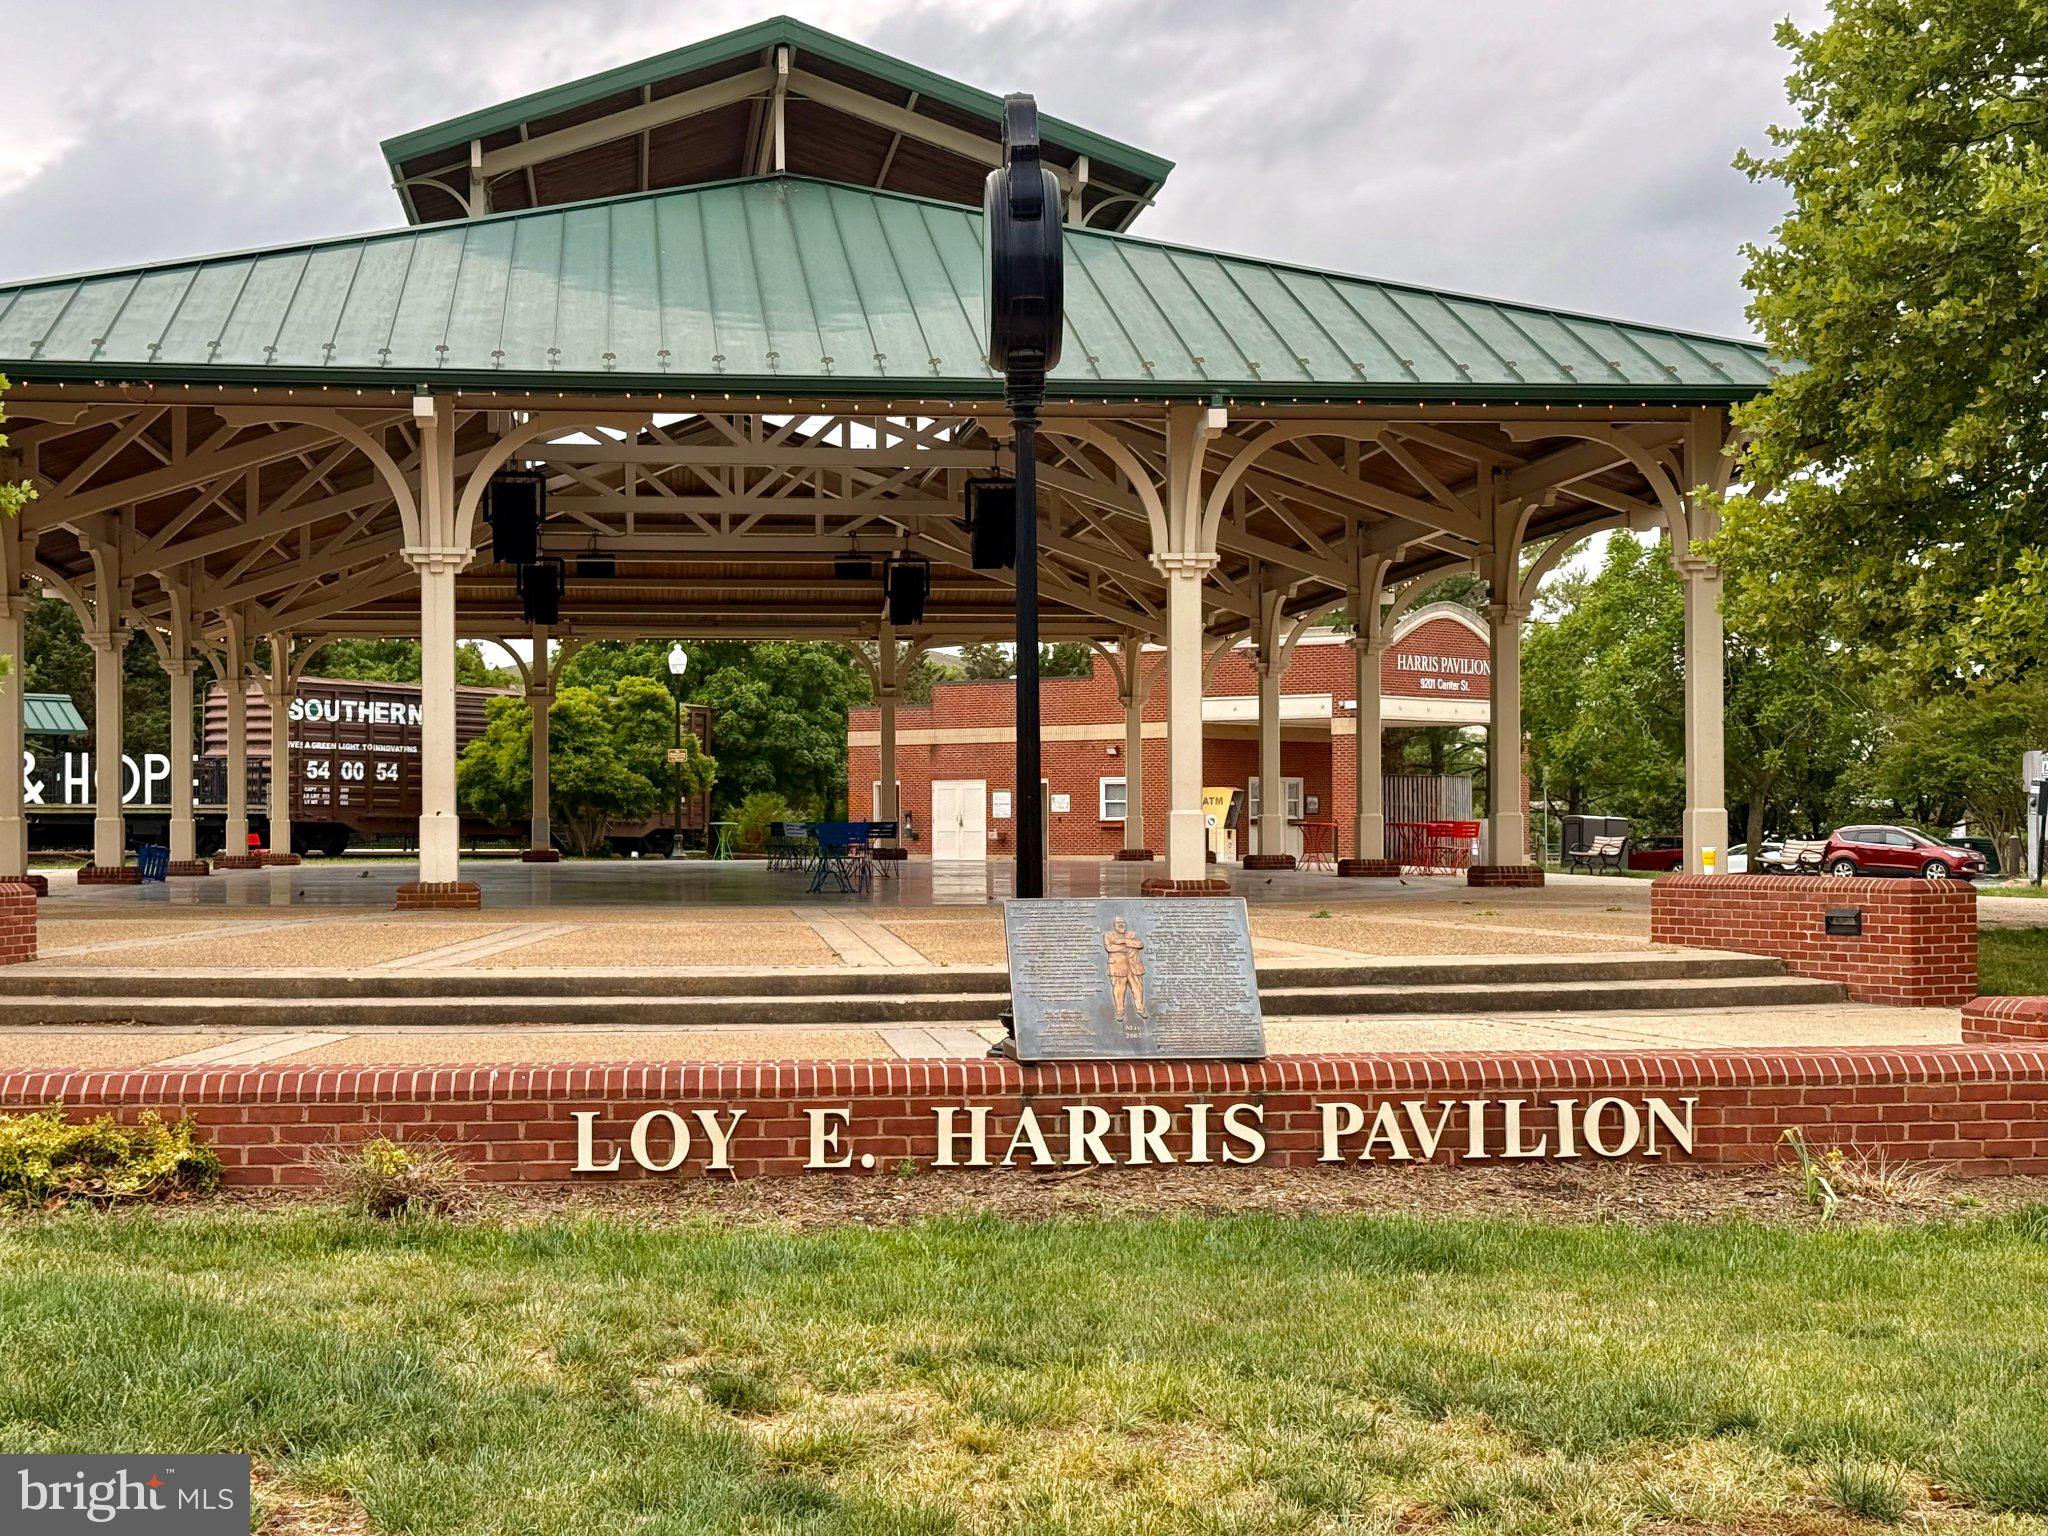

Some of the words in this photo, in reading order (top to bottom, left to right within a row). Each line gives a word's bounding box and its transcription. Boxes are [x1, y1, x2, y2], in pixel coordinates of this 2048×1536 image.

[1397, 654, 1439, 672] HARRIS
[1440, 657, 1491, 675] PAVILION
[1420, 678, 1436, 689] 9201
[1437, 679, 1460, 690] Center
[288, 698, 422, 725] SOUTHERN
[311, 741, 337, 750] GREEN
[362, 743, 373, 751] TO
[306, 761, 330, 779] 54
[376, 762, 398, 781] 54
[1202, 796, 1224, 806] ATM
[570, 1109, 748, 1173] LOY
[802, 1107, 876, 1169] E.
[930, 1102, 1266, 1167] HARRIS
[1315, 1097, 1699, 1163] PAVILION
